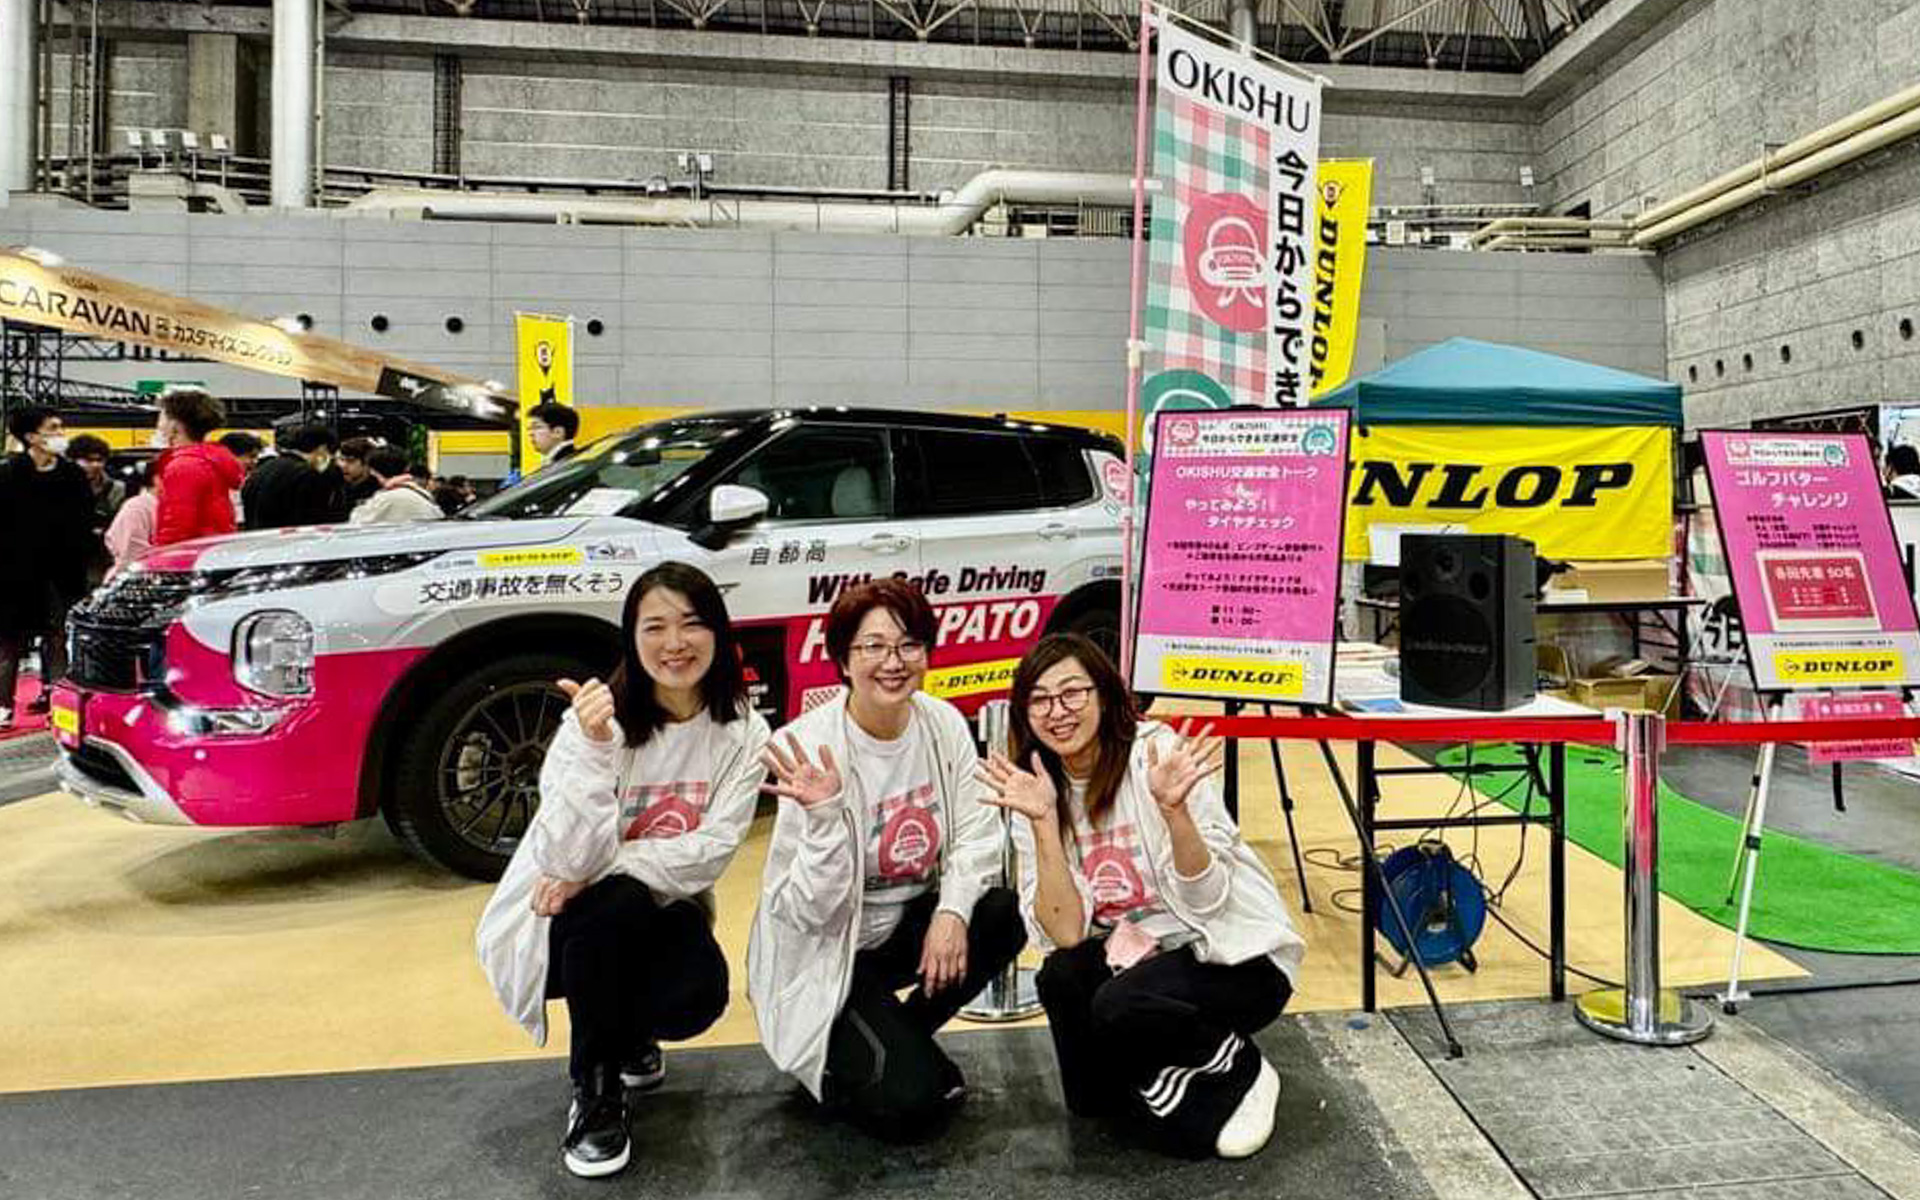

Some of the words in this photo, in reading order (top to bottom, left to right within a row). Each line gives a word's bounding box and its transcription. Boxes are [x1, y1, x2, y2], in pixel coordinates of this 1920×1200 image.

[1168, 48, 1310, 133] OKISHU
[0, 279, 150, 336] CARAVAN
[1350, 461, 1634, 508] NLOP
[1771, 491, 1849, 508] チャレンジ
[1207, 516, 1295, 529] タイヤチェック
[420, 573, 624, 604] 交通事故を無くそう
[957, 565, 1046, 593] Driving
[1190, 667, 1294, 684] DUNLOP
[1804, 660, 1894, 673] DUNLOP
